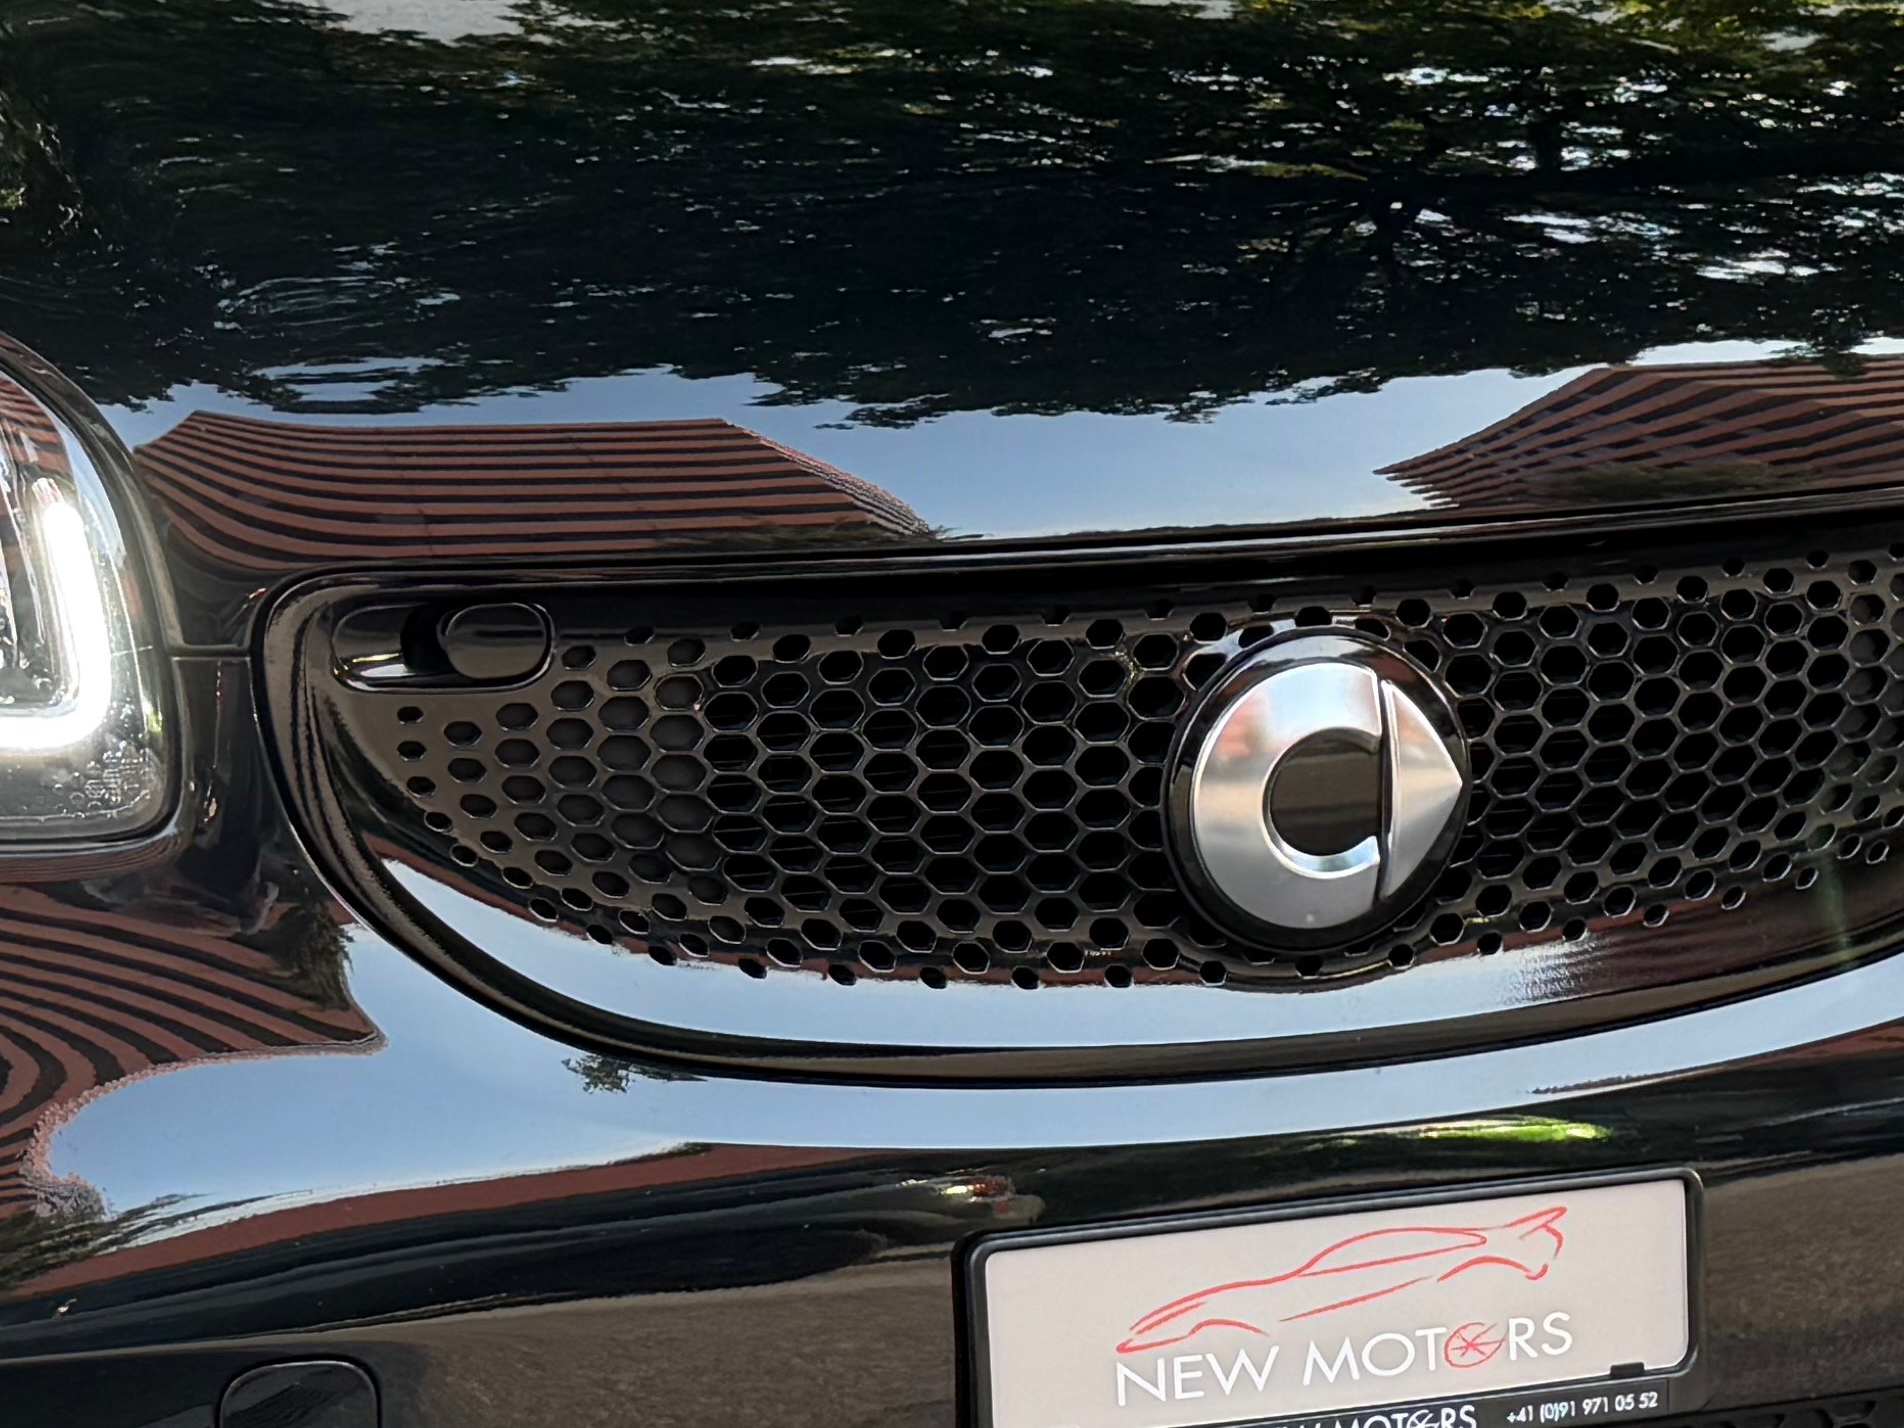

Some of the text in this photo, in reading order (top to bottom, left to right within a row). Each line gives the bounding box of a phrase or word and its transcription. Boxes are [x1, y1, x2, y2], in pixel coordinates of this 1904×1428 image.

[1114, 1311, 1575, 1408] NEW MOTORS
[1507, 1405, 1534, 1423] +41
[1539, 1400, 1577, 1424] (0)91
[1582, 1396, 1609, 1416] 971
[1614, 1393, 1636, 1412] 05
[1638, 1391, 1659, 1409] 52
